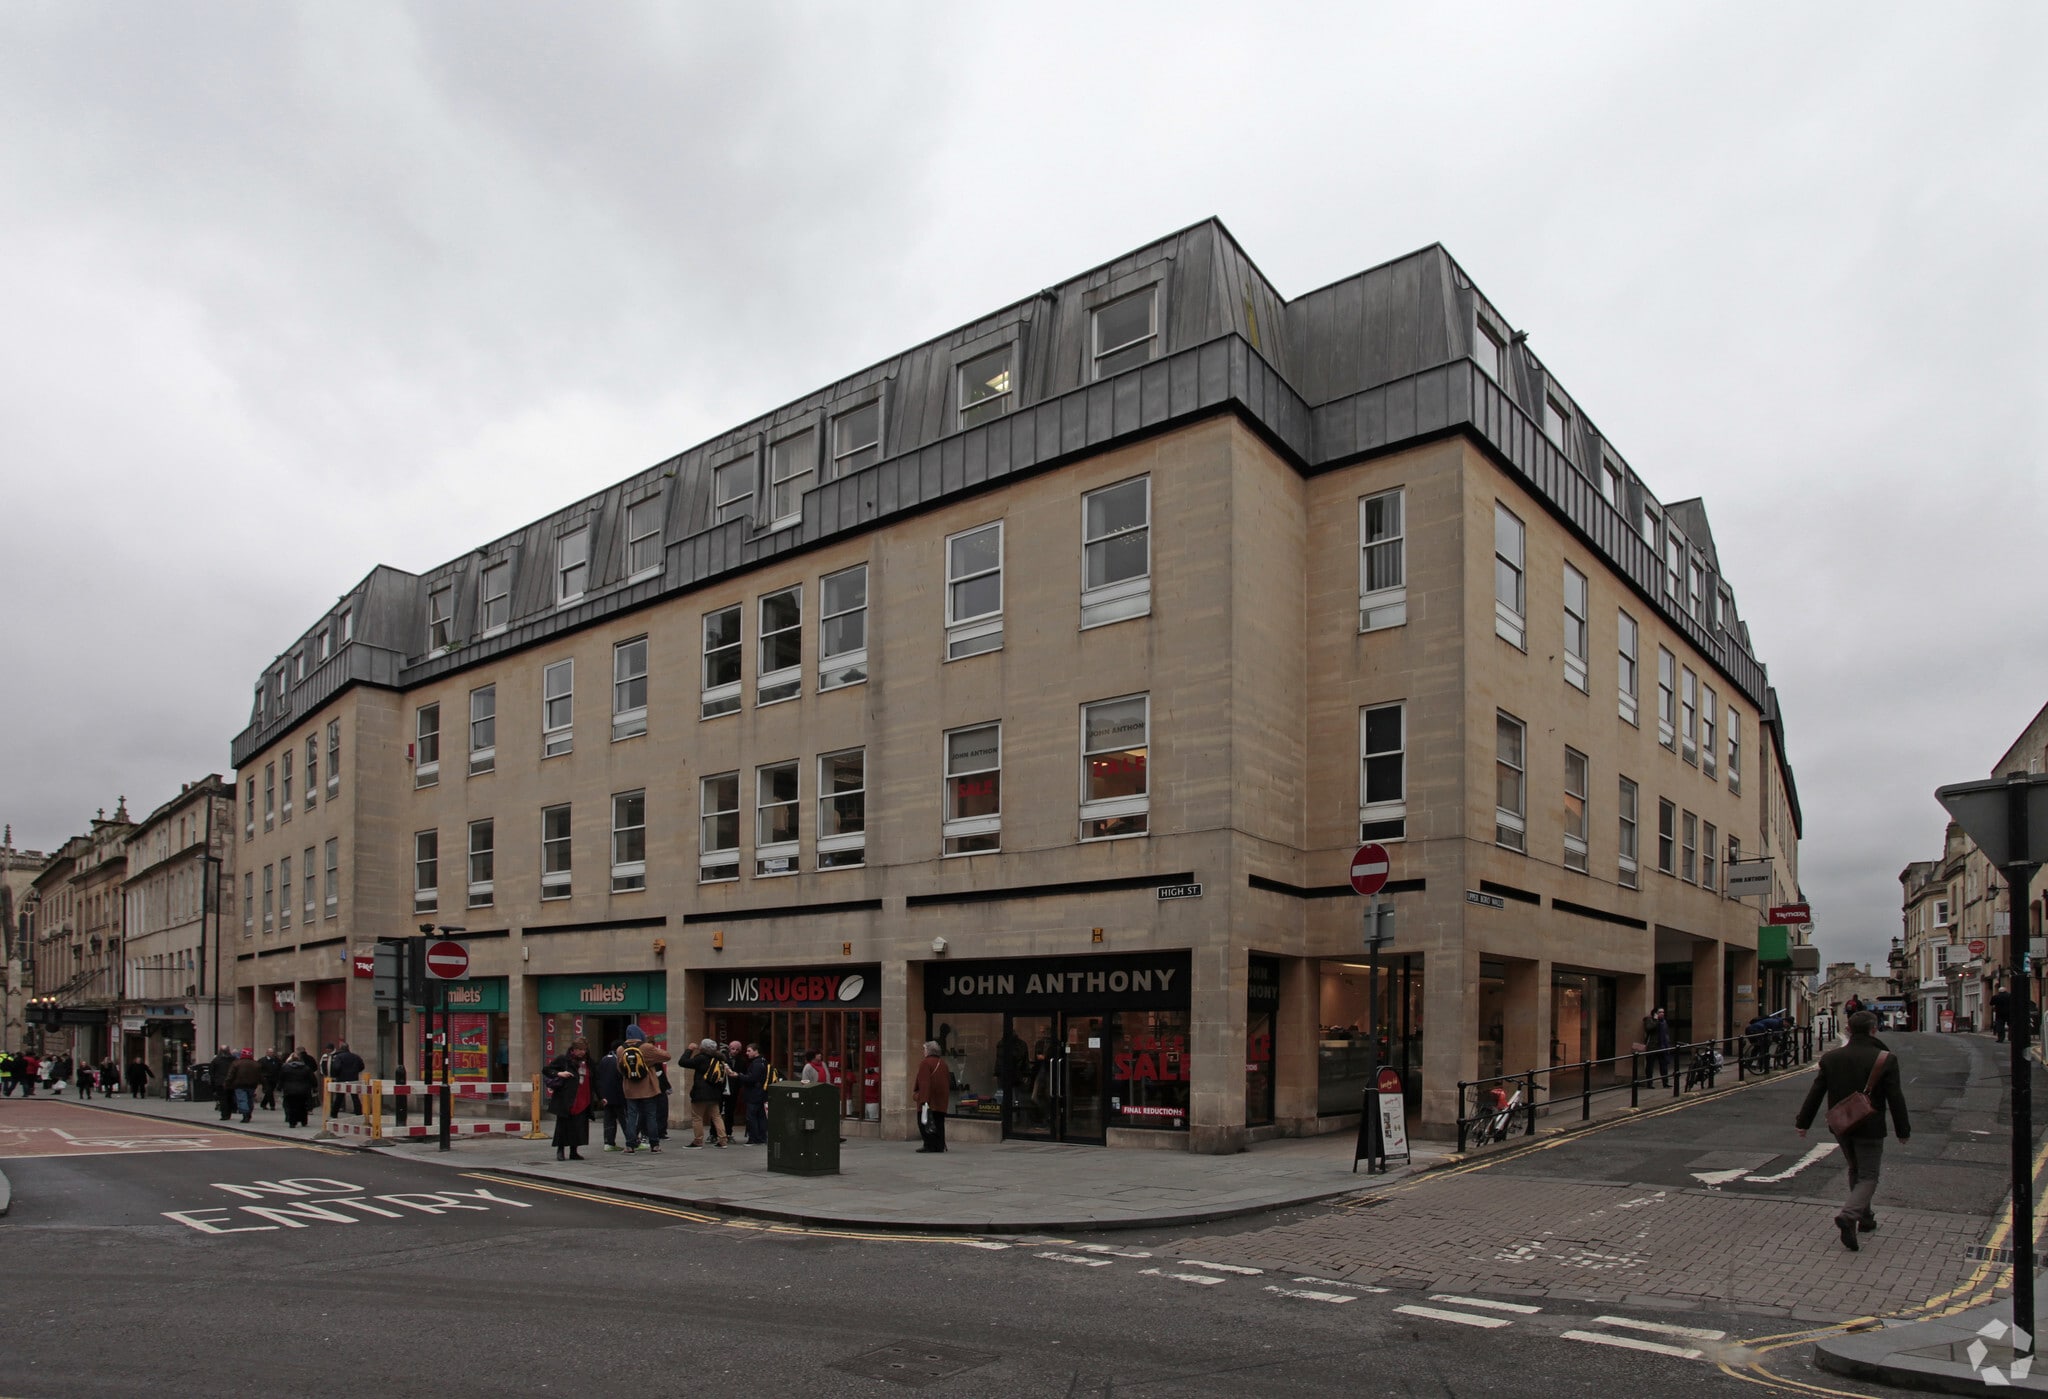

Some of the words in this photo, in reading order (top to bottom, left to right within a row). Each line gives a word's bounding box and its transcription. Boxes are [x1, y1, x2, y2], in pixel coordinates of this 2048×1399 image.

[1088, 729, 1110, 738] JOHN
[1112, 723, 1145, 734] ANTHON
[951, 752, 969, 761] JOHN
[970, 747, 998, 757] ANTHON
[1093, 756, 1145, 777] SALE
[958, 781, 993, 798] SALE
[1161, 887, 1184, 897] HIGH
[943, 974, 1014, 996] JOHN
[1025, 968, 1177, 994] ANTHONY
[448, 986, 481, 1003] millets
[580, 983, 625, 1002] millets
[1123, 1106, 1142, 1115] FINAL
[1143, 1107, 1184, 1117] REDUCTIONS
[210, 1177, 365, 1199] NO
[160, 1188, 533, 1235] ENTRY
